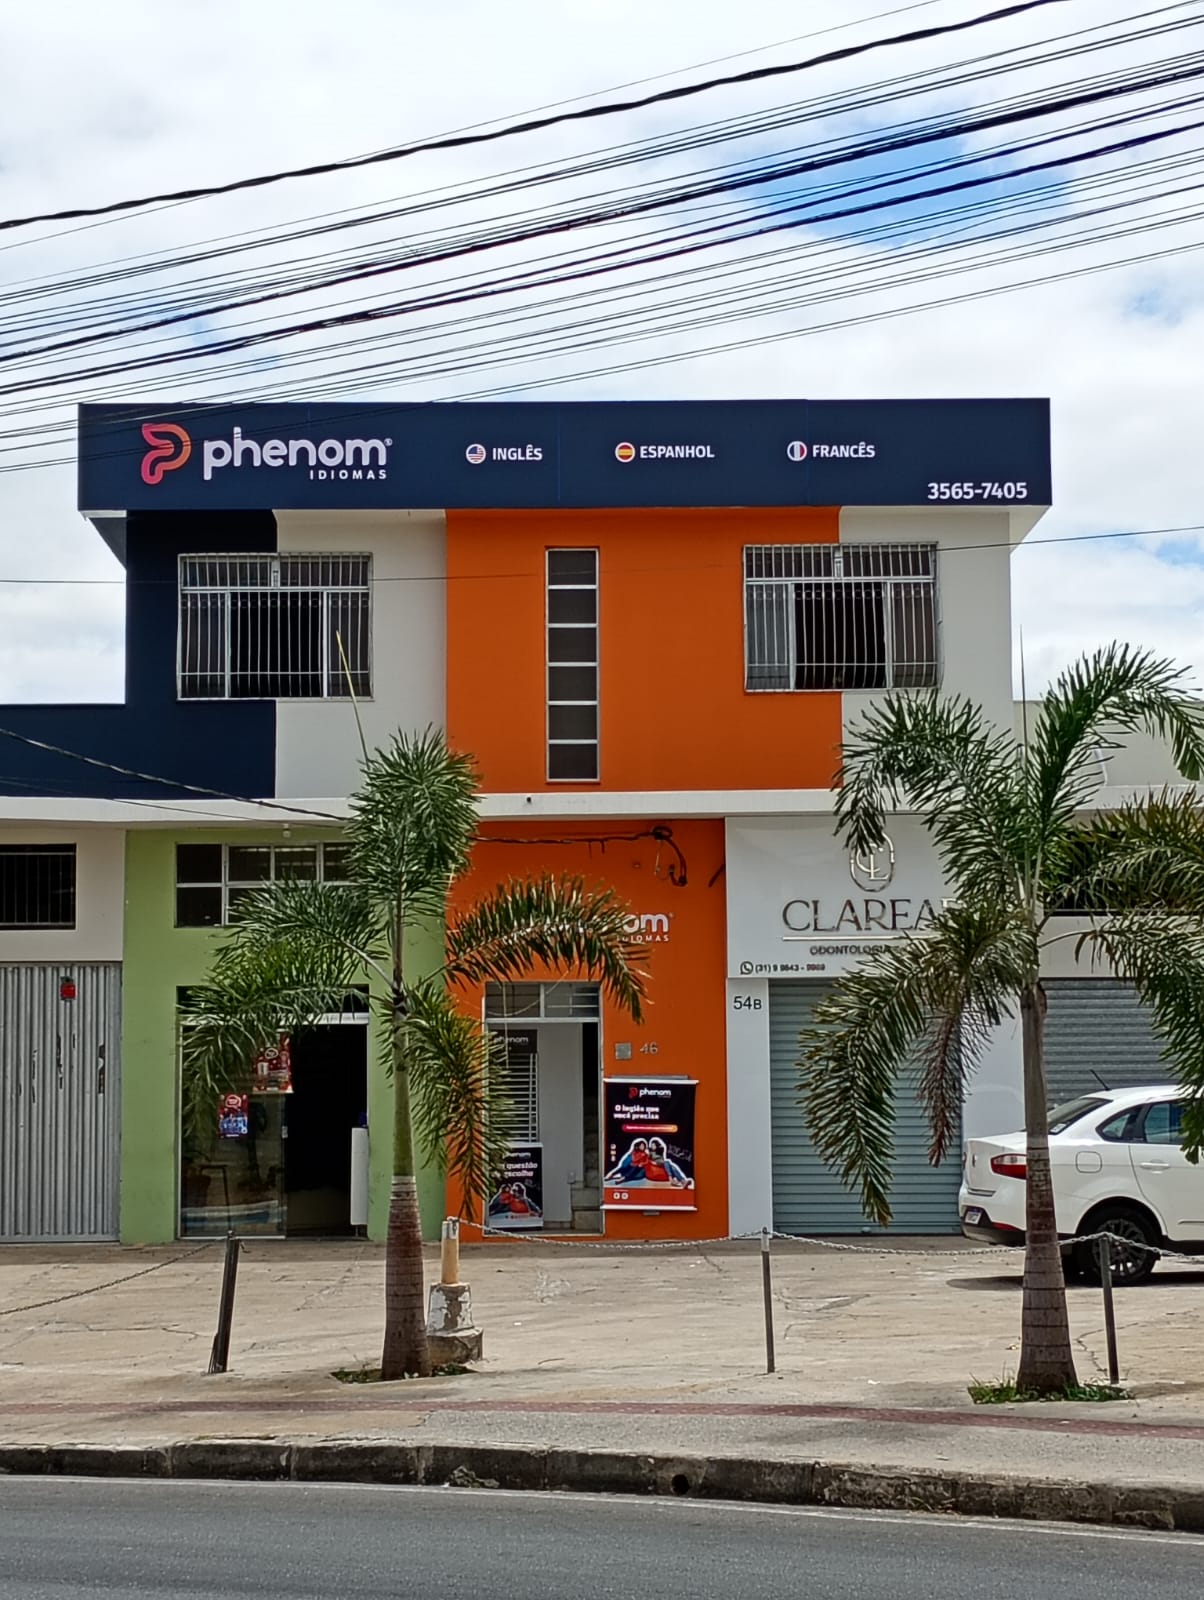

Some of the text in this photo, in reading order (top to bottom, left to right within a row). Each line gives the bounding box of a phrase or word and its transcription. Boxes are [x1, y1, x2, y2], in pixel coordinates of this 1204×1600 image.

[492, 444, 543, 461] INGLÊS
[639, 445, 715, 460] ESPANHOL
[812, 441, 876, 459] FRANCÊS
[309, 469, 387, 481] IDIOMAS
[927, 482, 1028, 500] 3565-7405
[782, 898, 962, 932] CLAREA
[733, 996, 762, 1010] 54B
[639, 1042, 659, 1055] 46
[639, 1087, 672, 1098] phenom
